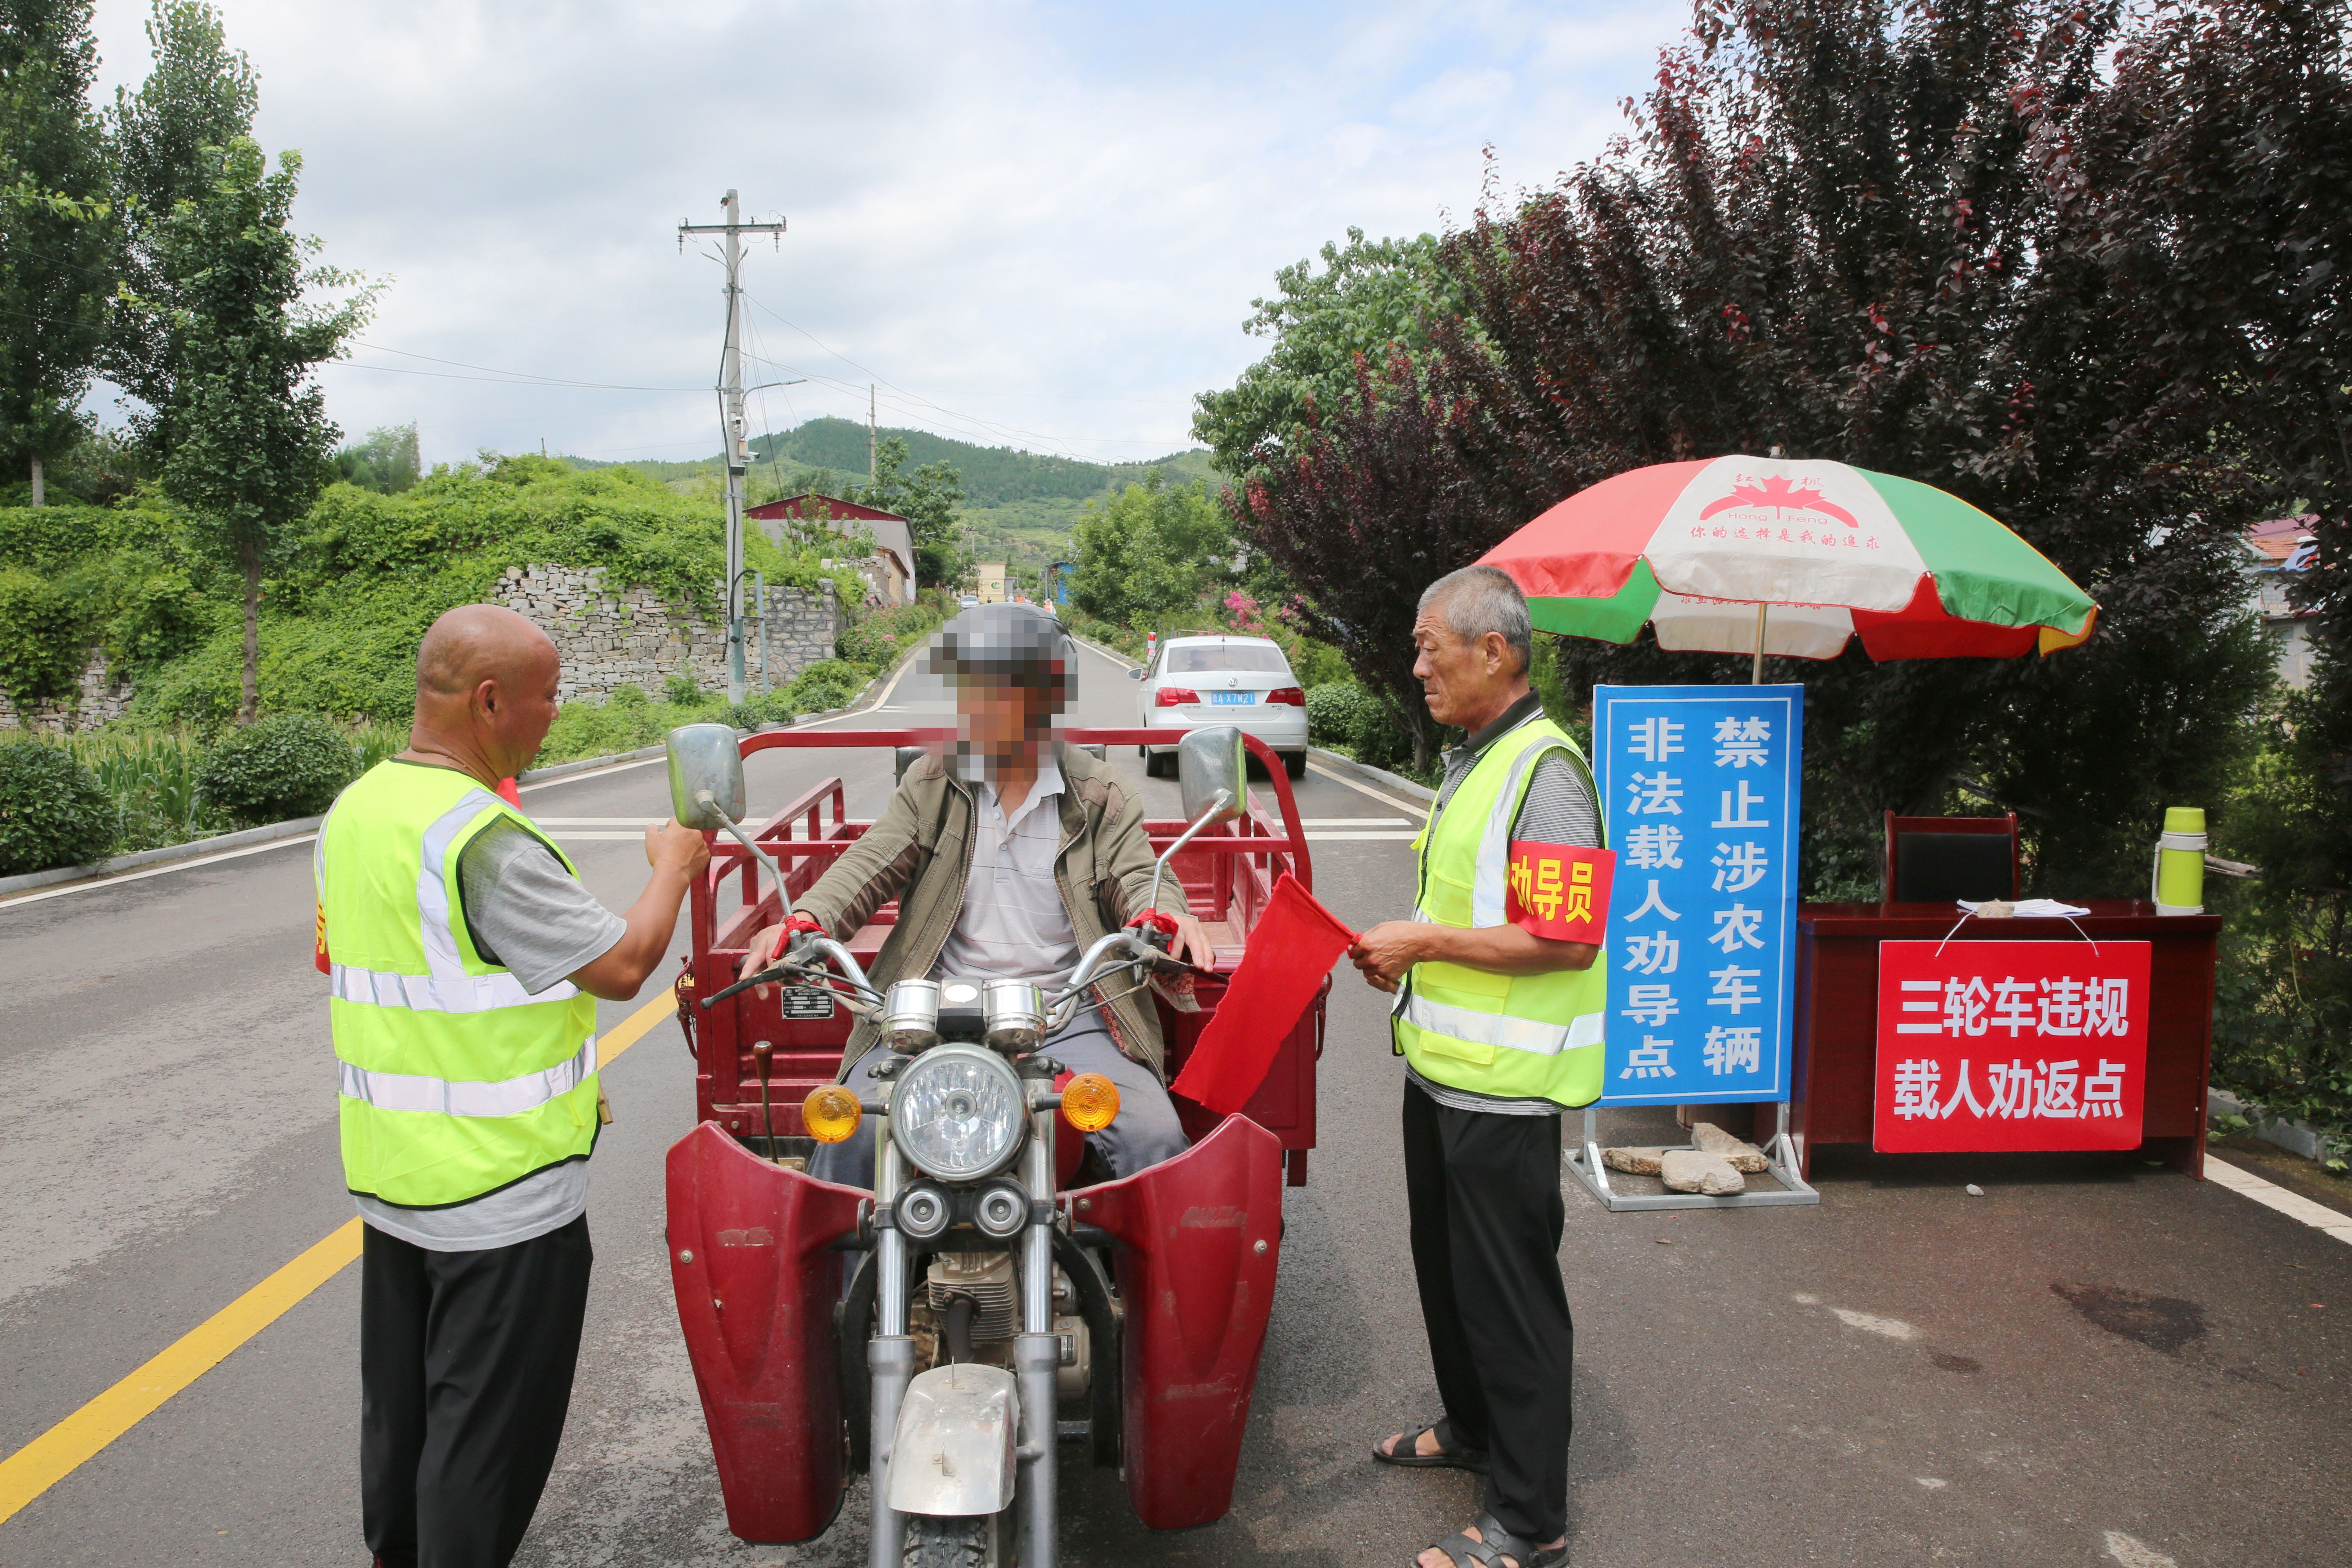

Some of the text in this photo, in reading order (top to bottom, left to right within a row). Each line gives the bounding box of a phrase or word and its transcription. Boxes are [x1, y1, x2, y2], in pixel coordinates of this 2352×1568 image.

[1735, 473, 1754, 483] 红
[1690, 525, 1880, 550] 你的选择是我的追求
[1728, 512, 1828, 525] Hong Feng
[1511, 855, 1592, 924] 劝导员
[1619, 717, 1685, 1080] 非法载人劝导点
[1702, 716, 1772, 1076] 禁止涉农车辆
[1897, 976, 2129, 1038] 三轮车违规
[1894, 1058, 2125, 1120] 载人劝返点
